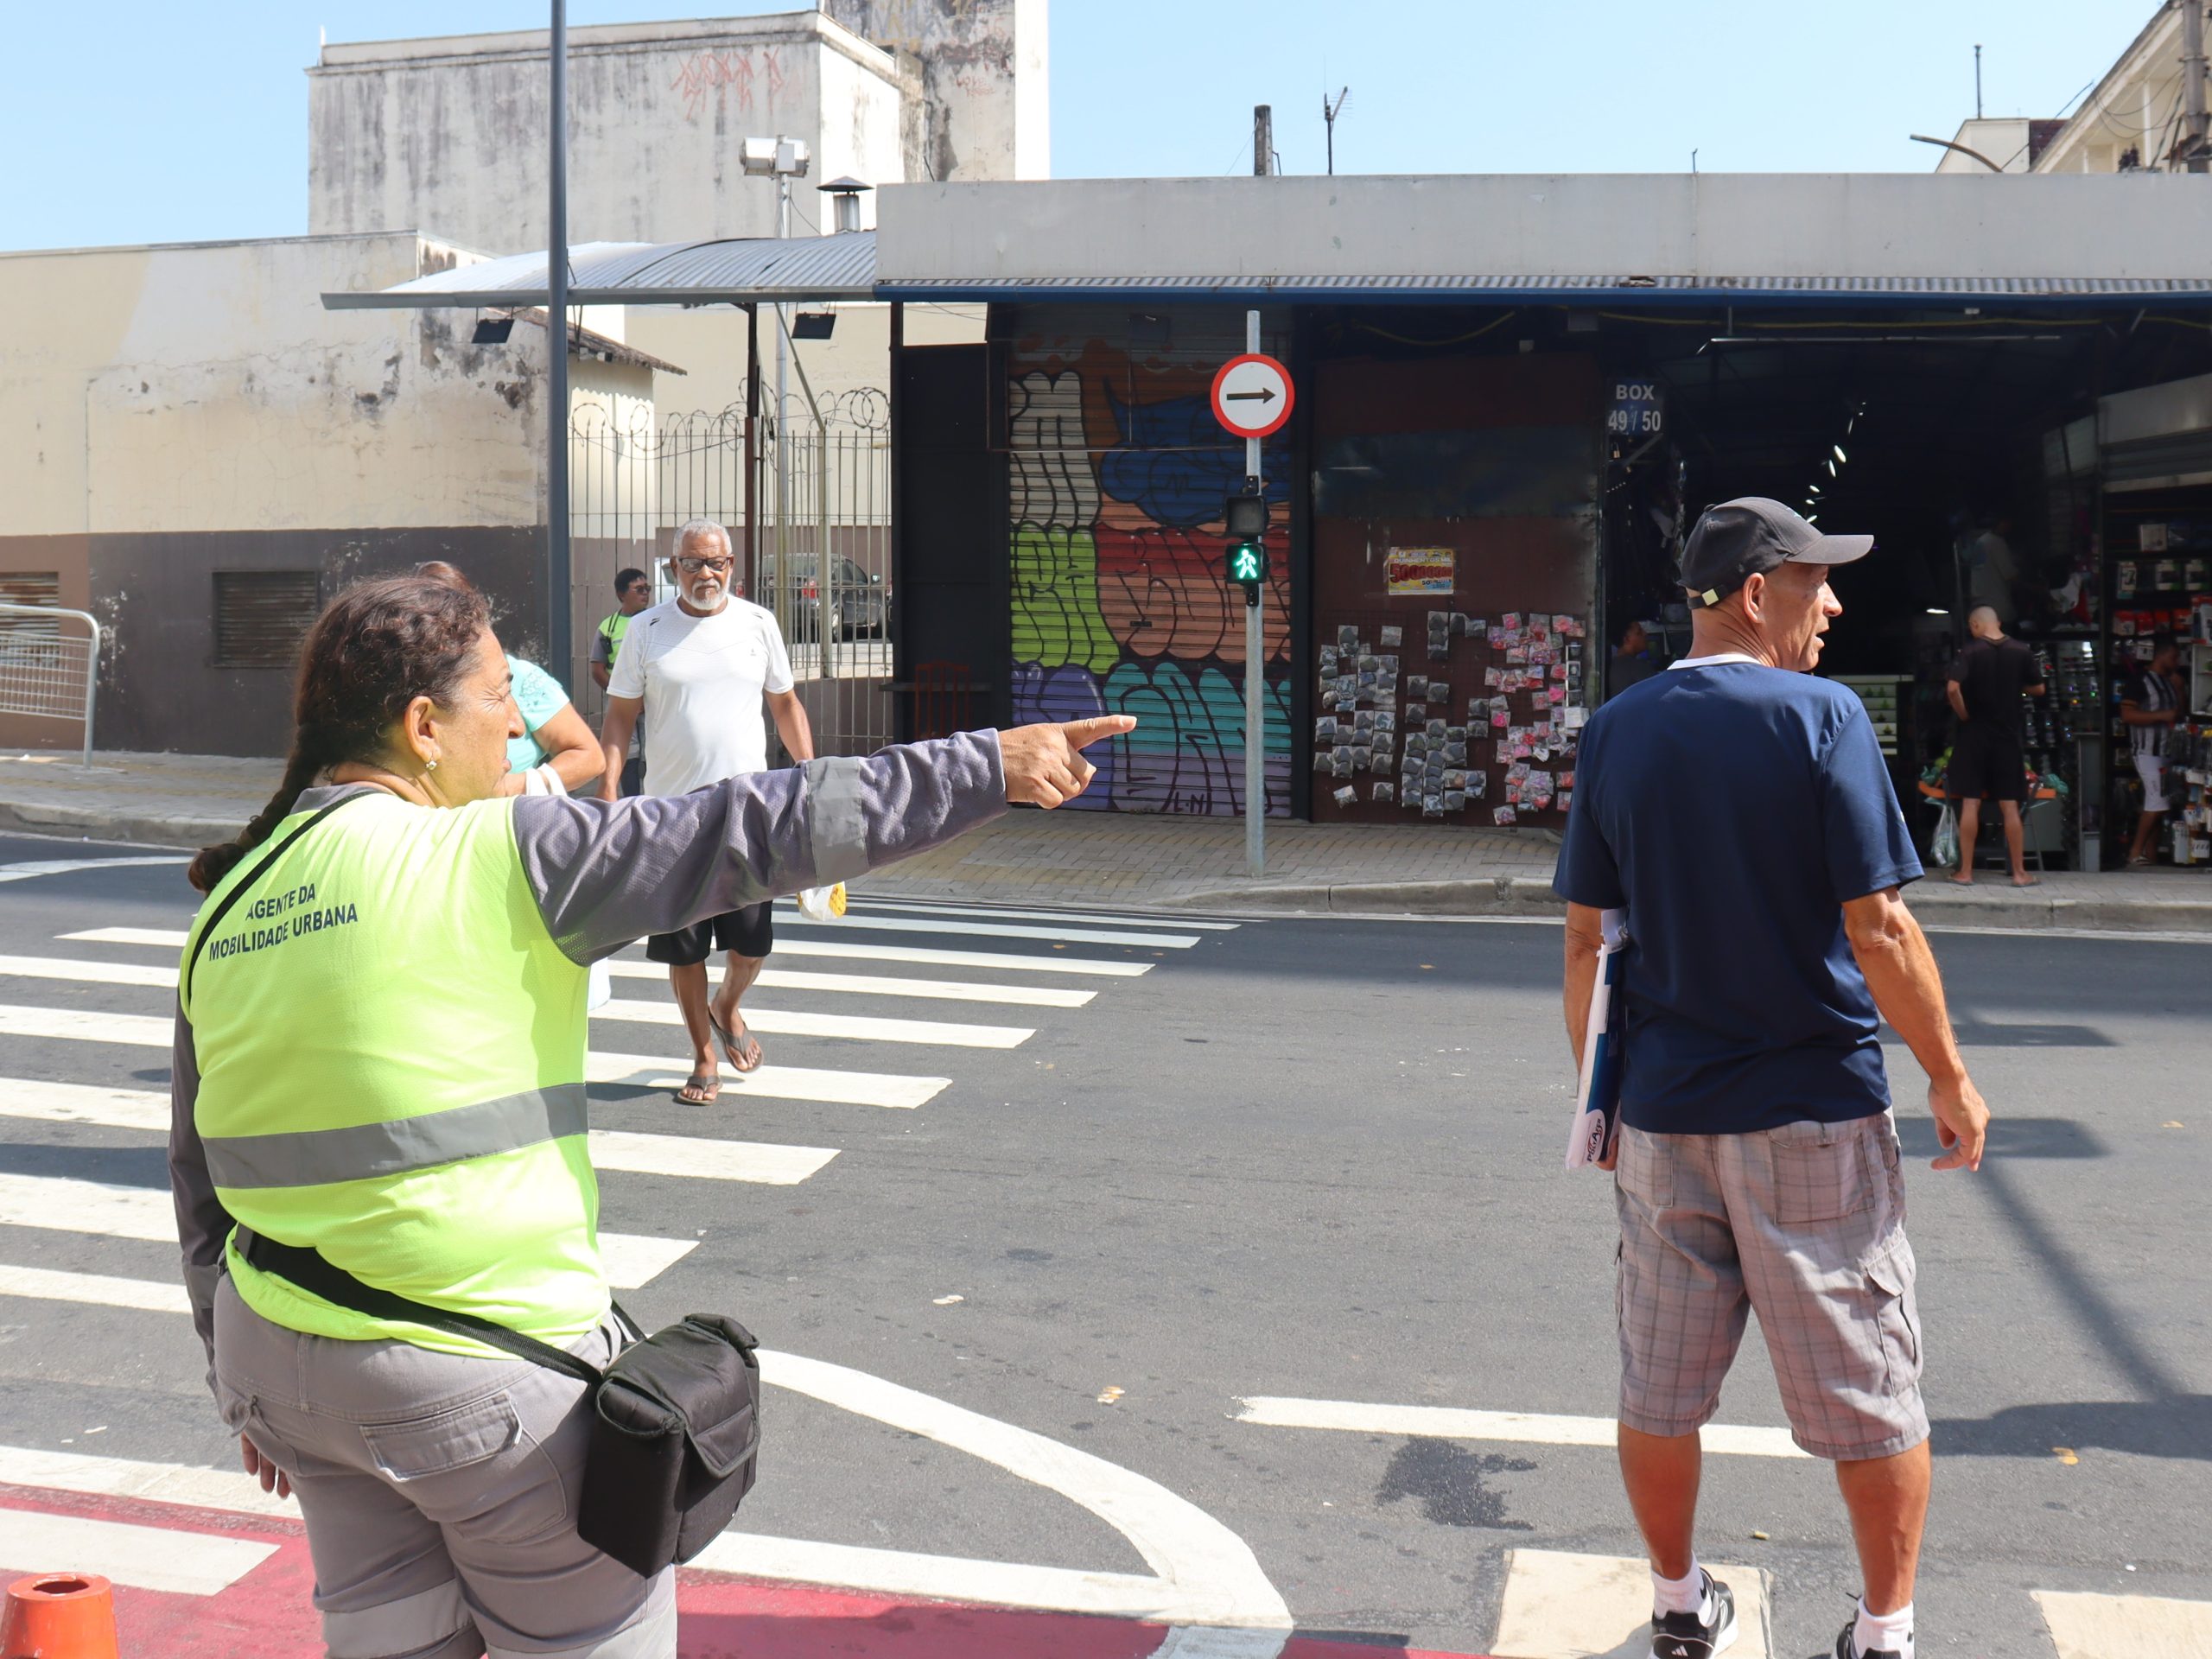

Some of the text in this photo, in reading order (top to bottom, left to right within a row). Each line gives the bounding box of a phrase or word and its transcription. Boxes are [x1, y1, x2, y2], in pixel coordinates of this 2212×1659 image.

[1616, 384, 1655, 401] BOX
[1608, 410, 1628, 431] 49
[1642, 410, 1662, 432] 50
[245, 883, 316, 921] AGENTE DA
[209, 903, 359, 962] MOBILIDADE URBANA
